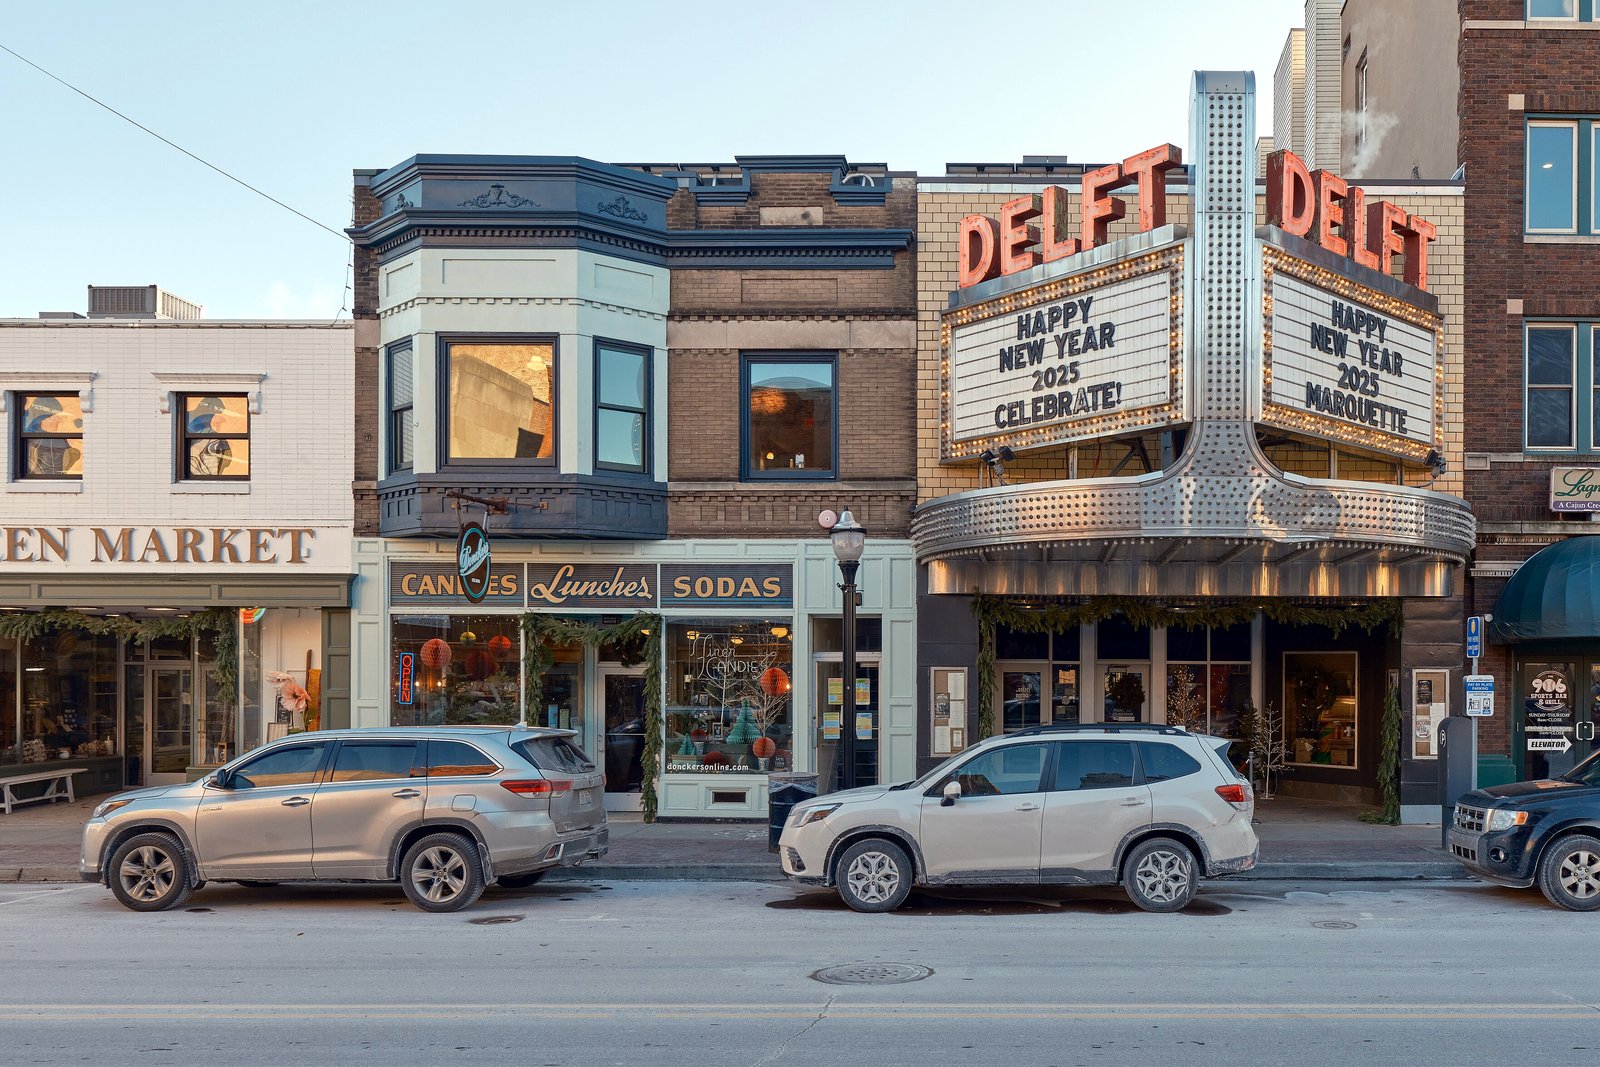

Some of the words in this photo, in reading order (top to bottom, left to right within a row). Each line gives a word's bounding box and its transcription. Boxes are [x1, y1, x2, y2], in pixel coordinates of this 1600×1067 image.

[959, 143, 1182, 288] DELFT
[1266, 149, 1437, 292] DELFT
[1017, 296, 1093, 340] HAPPY
[1332, 300, 1388, 343] HAPPY
[999, 339, 1045, 373] NEW
[1054, 321, 1115, 358] YEAR
[1310, 322, 1348, 358] NEW
[1359, 339, 1403, 377] YEAR
[1032, 362, 1080, 392] 2025
[1337, 363, 1380, 398] 2025
[995, 381, 1122, 429] CELEBRATE!
[1305, 381, 1408, 434] MARQUETTE
[1565, 501, 1586, 509] Cajun
[90, 527, 315, 564] MARKET
[401, 573, 517, 596] CANES
[530, 564, 653, 604] Lunches
[673, 576, 781, 598] SODAS
[402, 655, 412, 702] OPEN
[1532, 678, 1567, 693] 906
[666, 762, 749, 771] donckersonline.com
